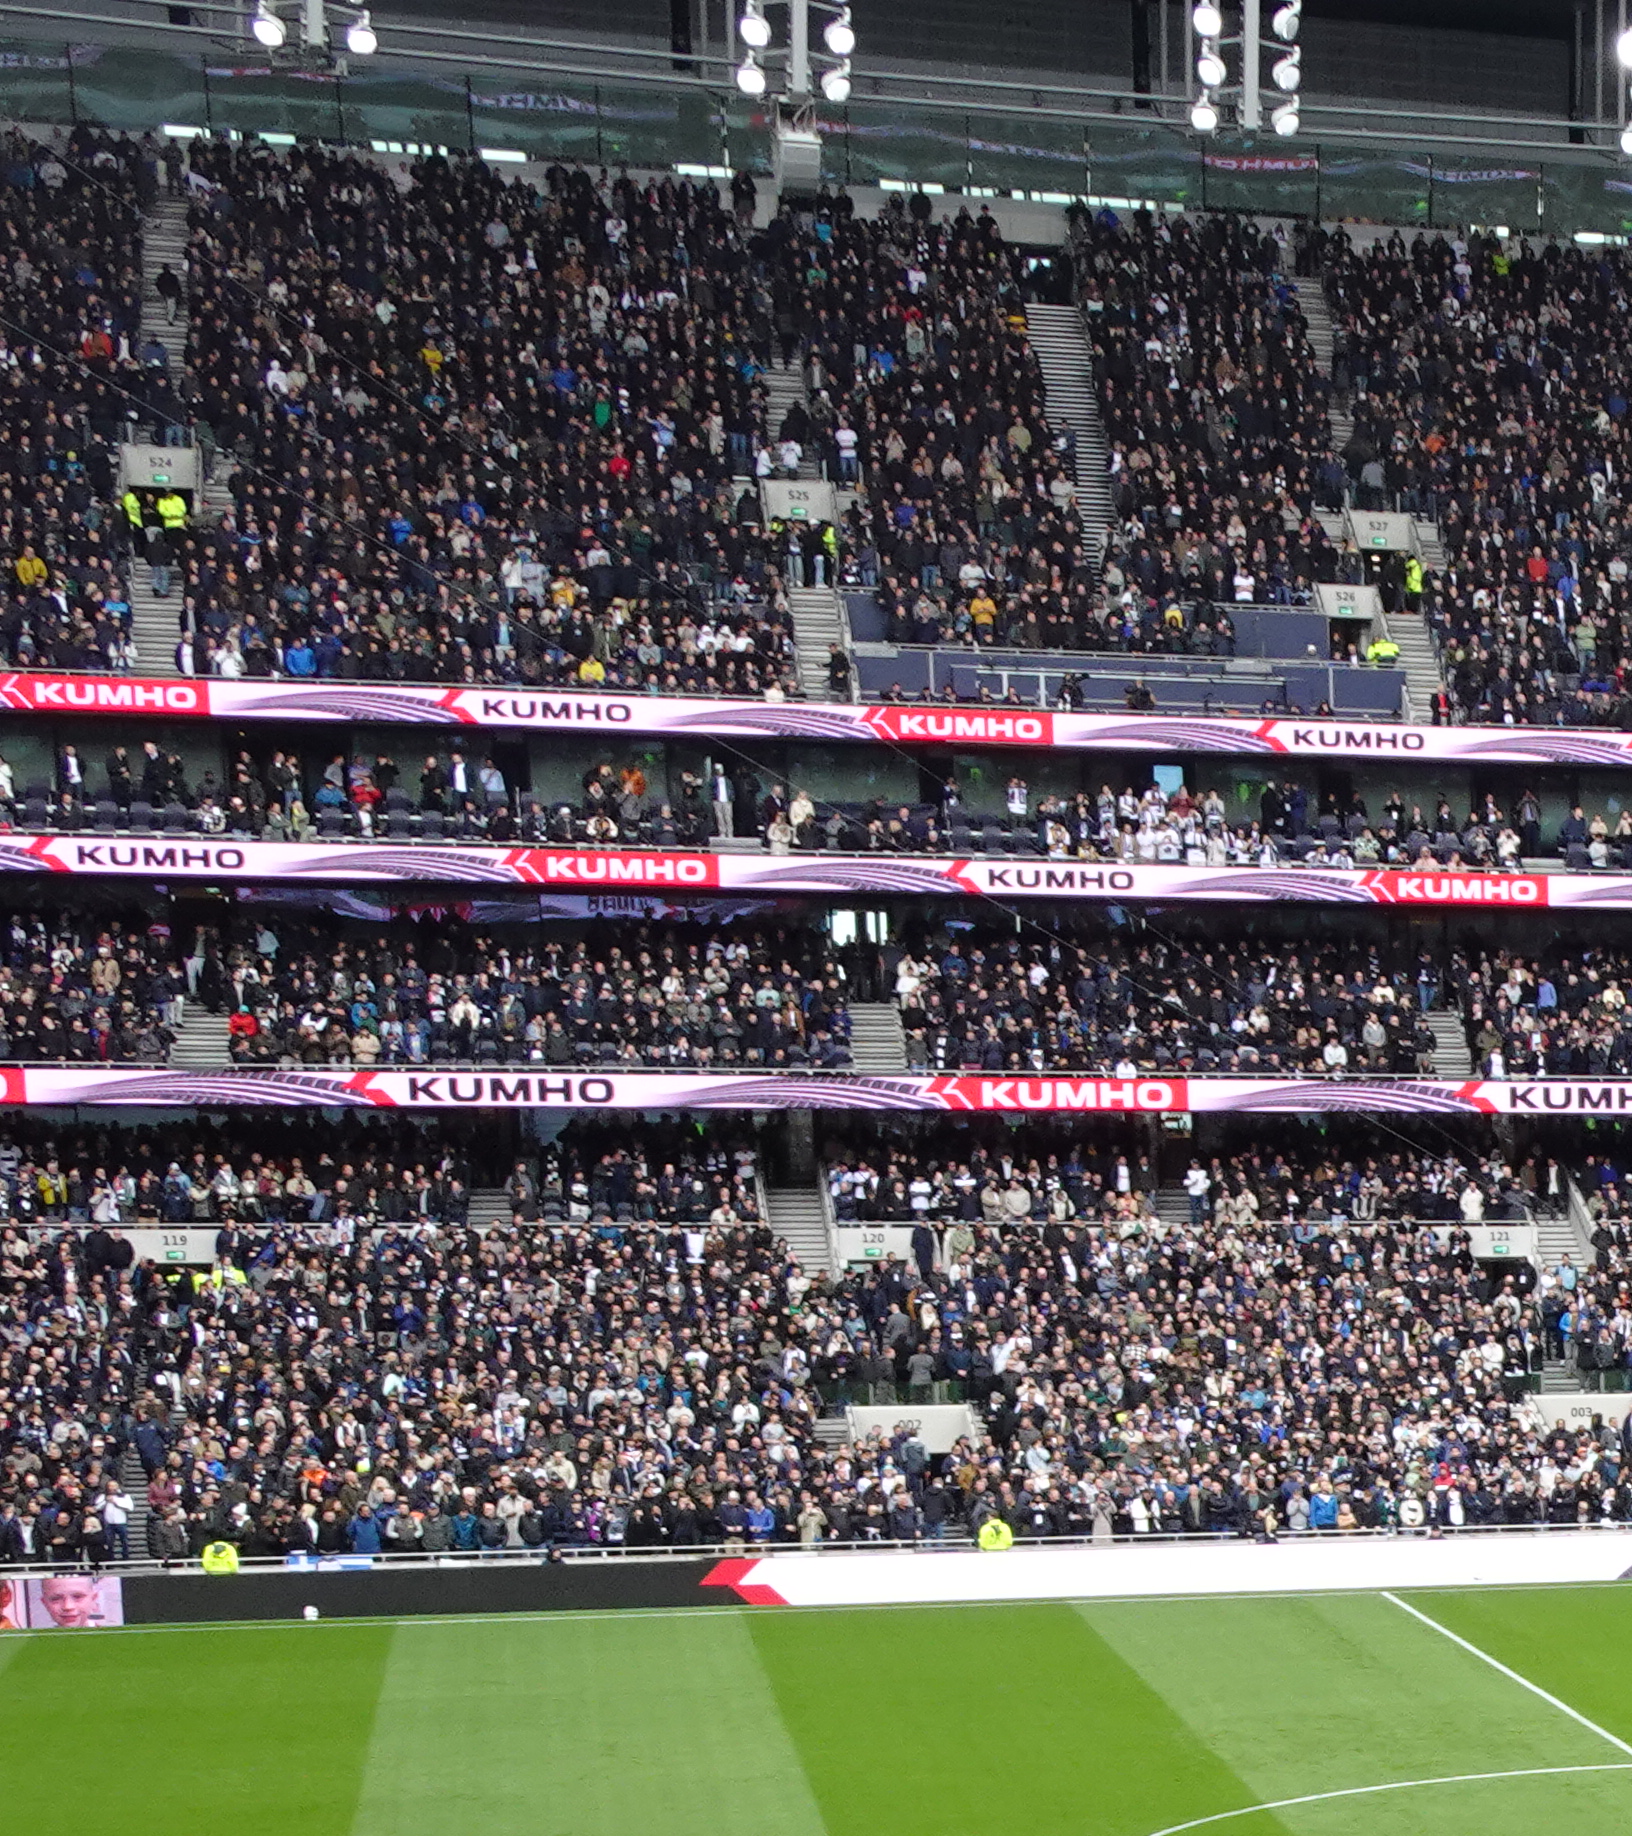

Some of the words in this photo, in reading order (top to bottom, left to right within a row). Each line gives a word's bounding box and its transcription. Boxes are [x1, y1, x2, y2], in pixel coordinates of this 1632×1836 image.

[149, 457, 172, 468] 524
[788, 489, 810, 501] 525
[34, 681, 197, 709] KUMHO
[483, 700, 630, 721] KUMHO
[899, 714, 1043, 739] KUMHO
[1294, 730, 1424, 749] KUMHO
[78, 847, 243, 868] KUMHO
[546, 856, 707, 882] KUMHO
[989, 869, 1133, 889] KUMHO
[1397, 877, 1538, 902] KUMHO
[409, 1078, 613, 1103] KUMHO
[981, 1081, 1174, 1109] KUMHO
[162, 1235, 188, 1246] 119
[862, 1233, 885, 1244] 120
[1490, 1231, 1510, 1242] 121
[1571, 1407, 1593, 1418] 003
